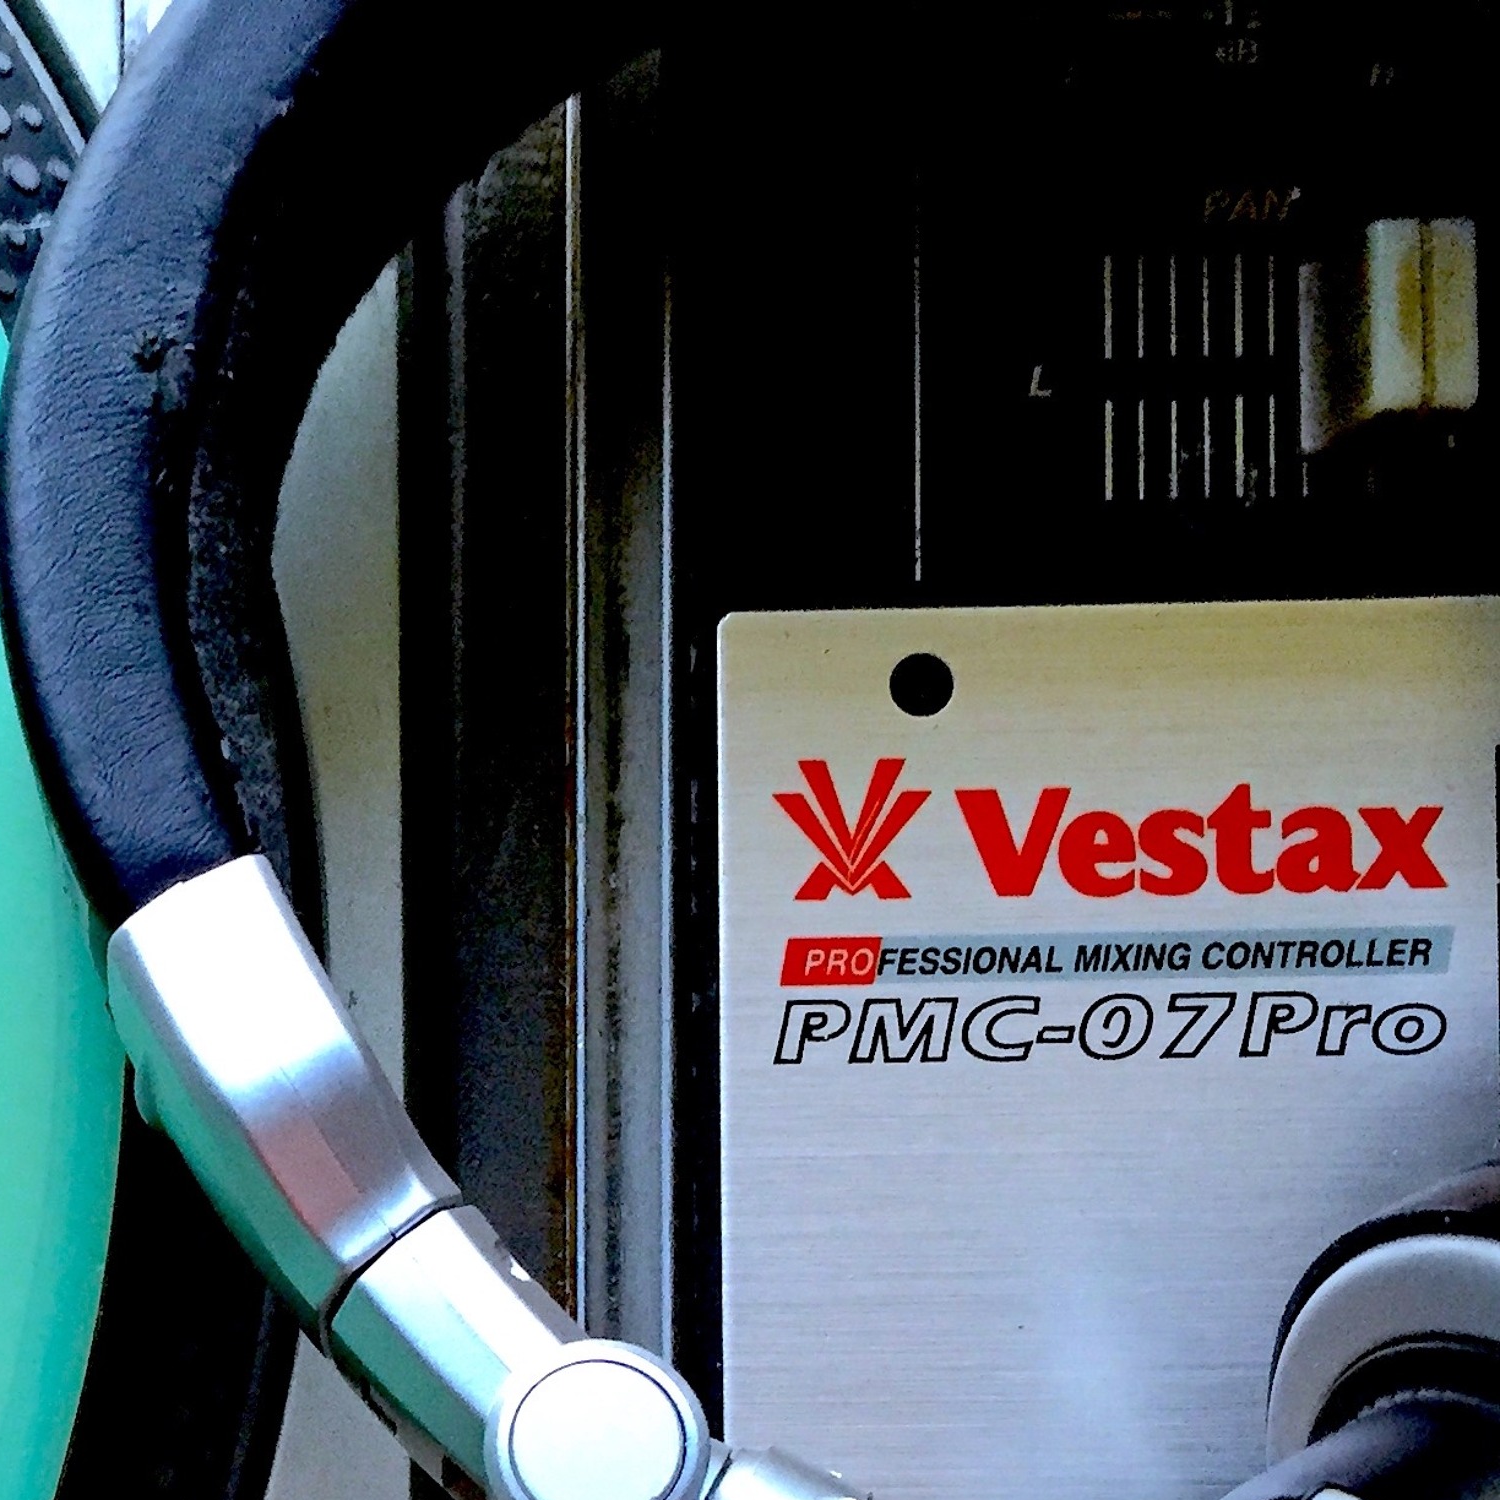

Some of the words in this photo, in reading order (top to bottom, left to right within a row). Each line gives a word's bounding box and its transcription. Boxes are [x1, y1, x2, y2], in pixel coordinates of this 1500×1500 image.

[1029, 365, 1052, 397] L
[955, 784, 1448, 897] Vestax
[803, 945, 1063, 977] PROFESSIONAL
[1073, 944, 1191, 974] MIXING
[1202, 939, 1432, 971] CONTROLLER
[773, 991, 1448, 1065] PMC-07Pro
